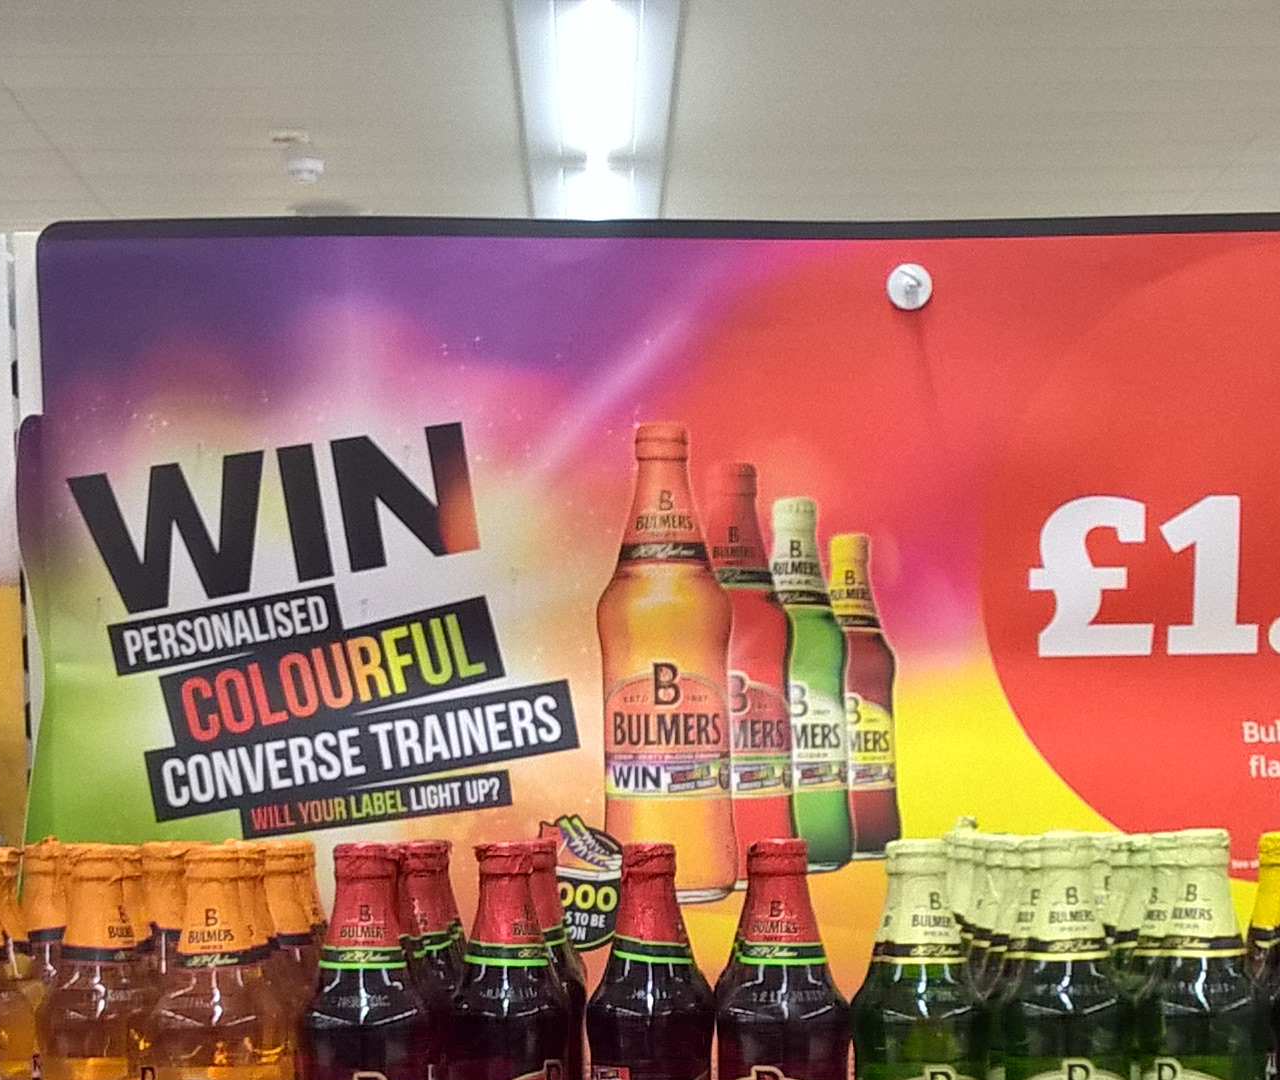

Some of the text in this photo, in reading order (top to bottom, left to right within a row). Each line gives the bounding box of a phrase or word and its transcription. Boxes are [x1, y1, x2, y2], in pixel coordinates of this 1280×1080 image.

[67, 422, 480, 613] WIN
[123, 596, 328, 665] PERSONALISED
[180, 614, 486, 742] COLOURFUL
[161, 696, 562, 808] CONVERSE TRAINERS
[612, 712, 721, 746] BULMERS
[251, 779, 500, 830] WILL YOUR LABEL LIGHT UP?
[611, 764, 661, 789] WIN
